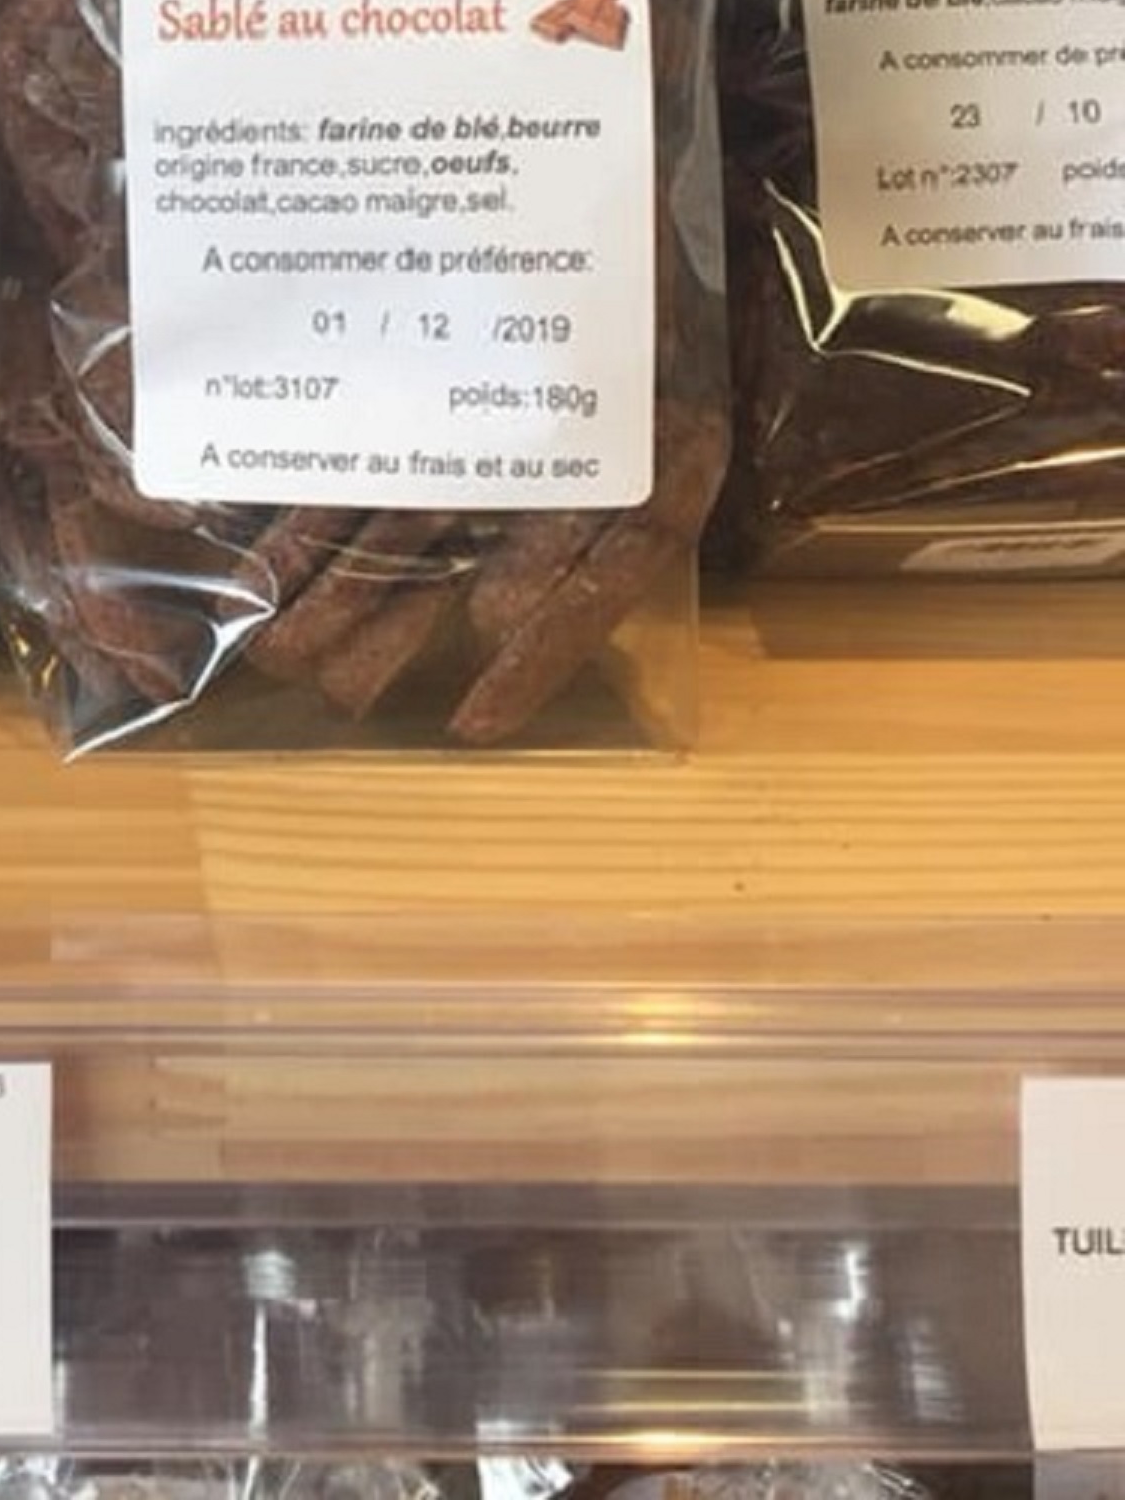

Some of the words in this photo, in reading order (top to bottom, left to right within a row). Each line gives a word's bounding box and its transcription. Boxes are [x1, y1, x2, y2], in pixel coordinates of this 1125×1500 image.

[277, 9, 328, 39] au
[879, 51, 899, 70] A
[903, 49, 1047, 70] consommer
[1055, 44, 1089, 66] de
[950, 103, 981, 129] 23
[1069, 99, 1101, 124] 10
[317, 117, 404, 143] farine
[409, 118, 446, 141] de
[155, 152, 245, 182] origine
[876, 166, 916, 190] Lot
[881, 225, 900, 246] A
[907, 222, 1026, 246] conserver
[1032, 223, 1063, 241] au
[203, 247, 224, 272] A
[229, 251, 391, 274] consommer
[396, 247, 433, 273] de
[439, 246, 594, 279] préférence:
[312, 309, 347, 335] 01
[417, 312, 450, 340] 12
[492, 314, 571, 343] /2019
[200, 443, 221, 468] A
[227, 447, 359, 474] conserver
[367, 453, 400, 476] au
[408, 450, 467, 478] frais
[474, 453, 504, 478] et
[511, 456, 544, 478] au
[549, 456, 600, 478] sec
